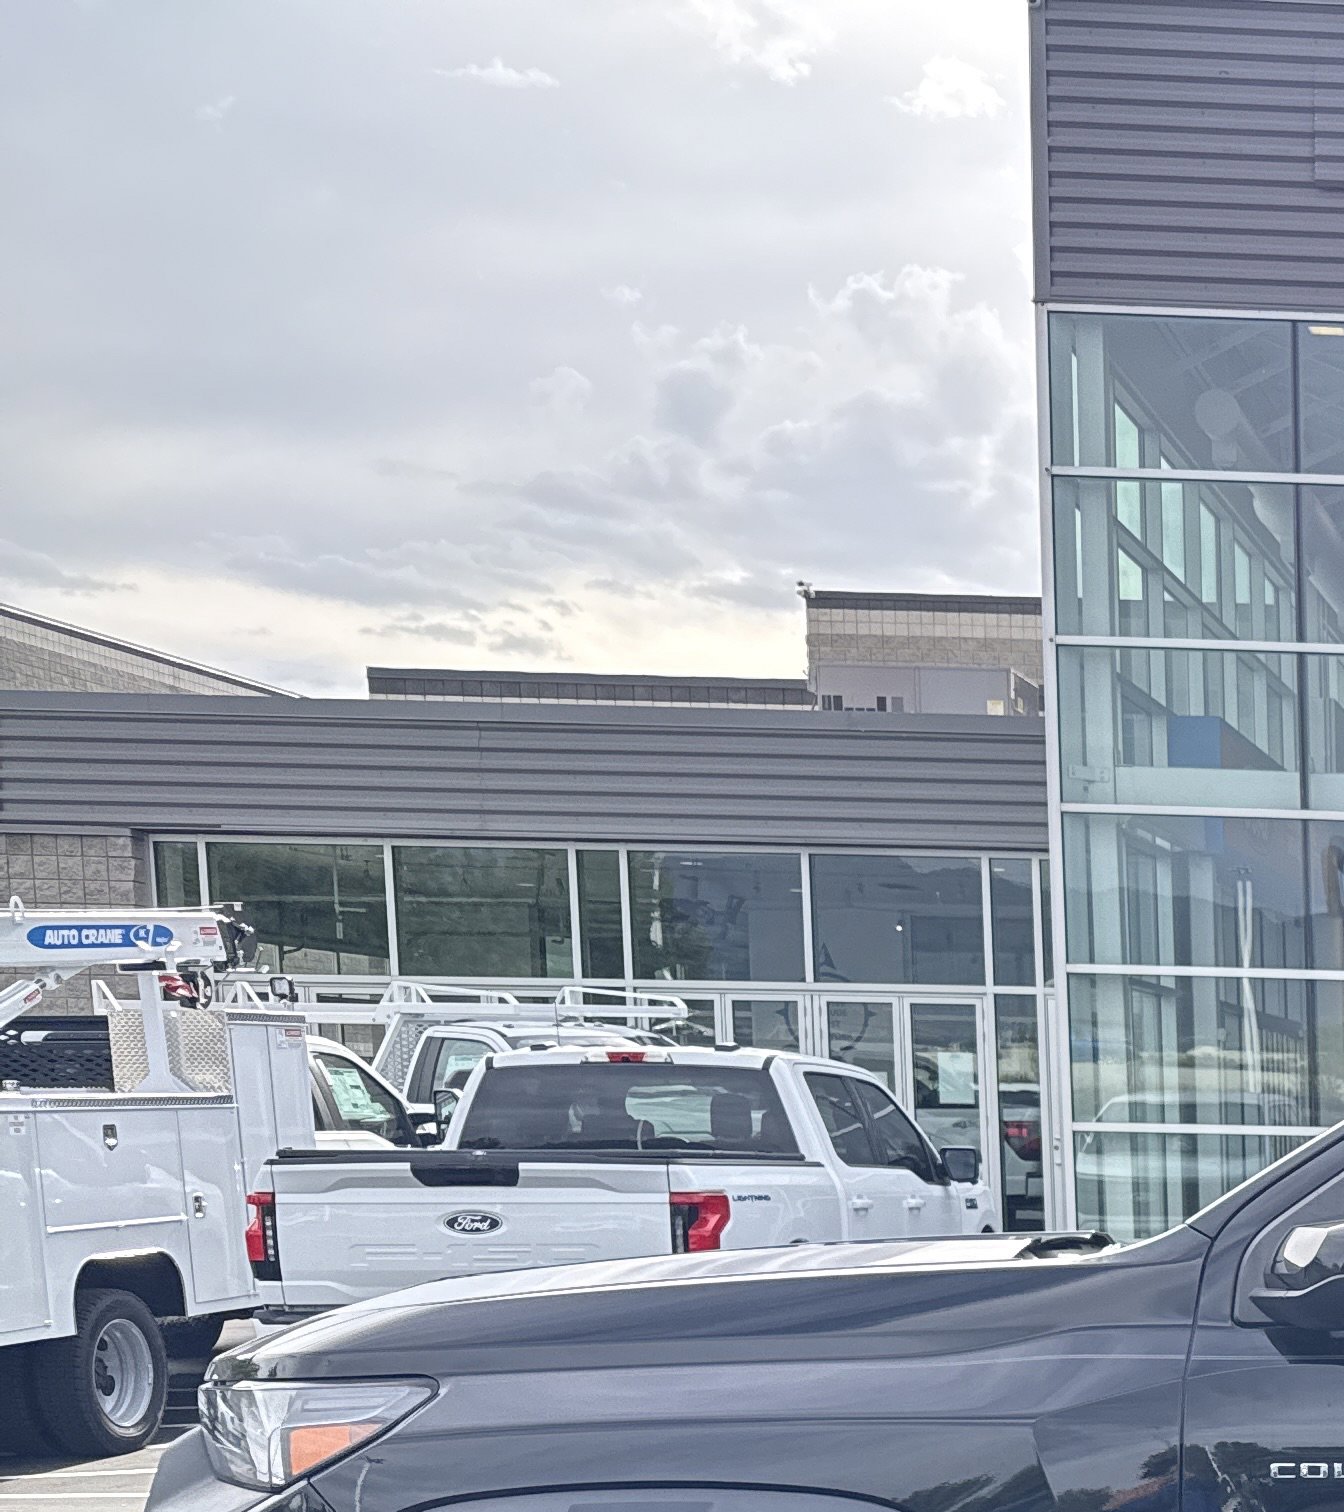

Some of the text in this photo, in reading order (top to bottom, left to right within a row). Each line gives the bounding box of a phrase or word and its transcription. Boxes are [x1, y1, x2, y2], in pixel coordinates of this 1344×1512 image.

[44, 929, 79, 945] AUTO
[81, 928, 123, 944] CRANE
[453, 1214, 491, 1231] Ford
